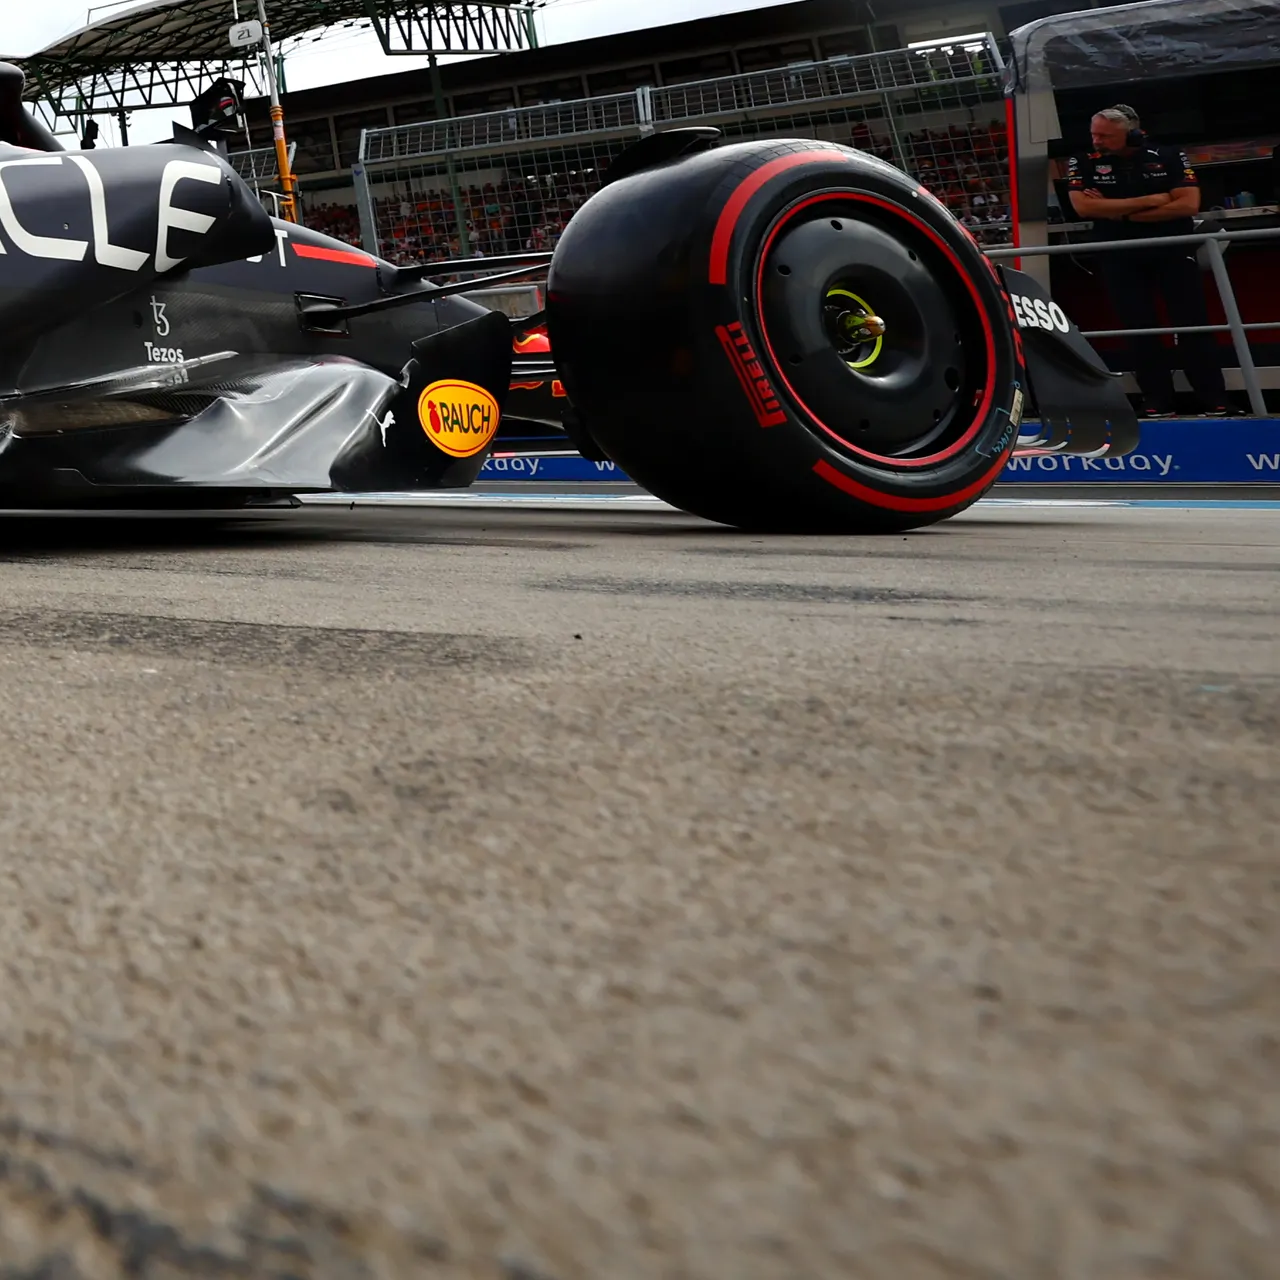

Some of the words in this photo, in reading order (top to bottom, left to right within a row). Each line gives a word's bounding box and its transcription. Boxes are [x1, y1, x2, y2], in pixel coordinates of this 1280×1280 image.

[237, 28, 253, 41] 21
[145, 341, 185, 363] Tezos
[714, 321, 788, 428] PIRELLI
[439, 402, 491, 434] RAUCH
